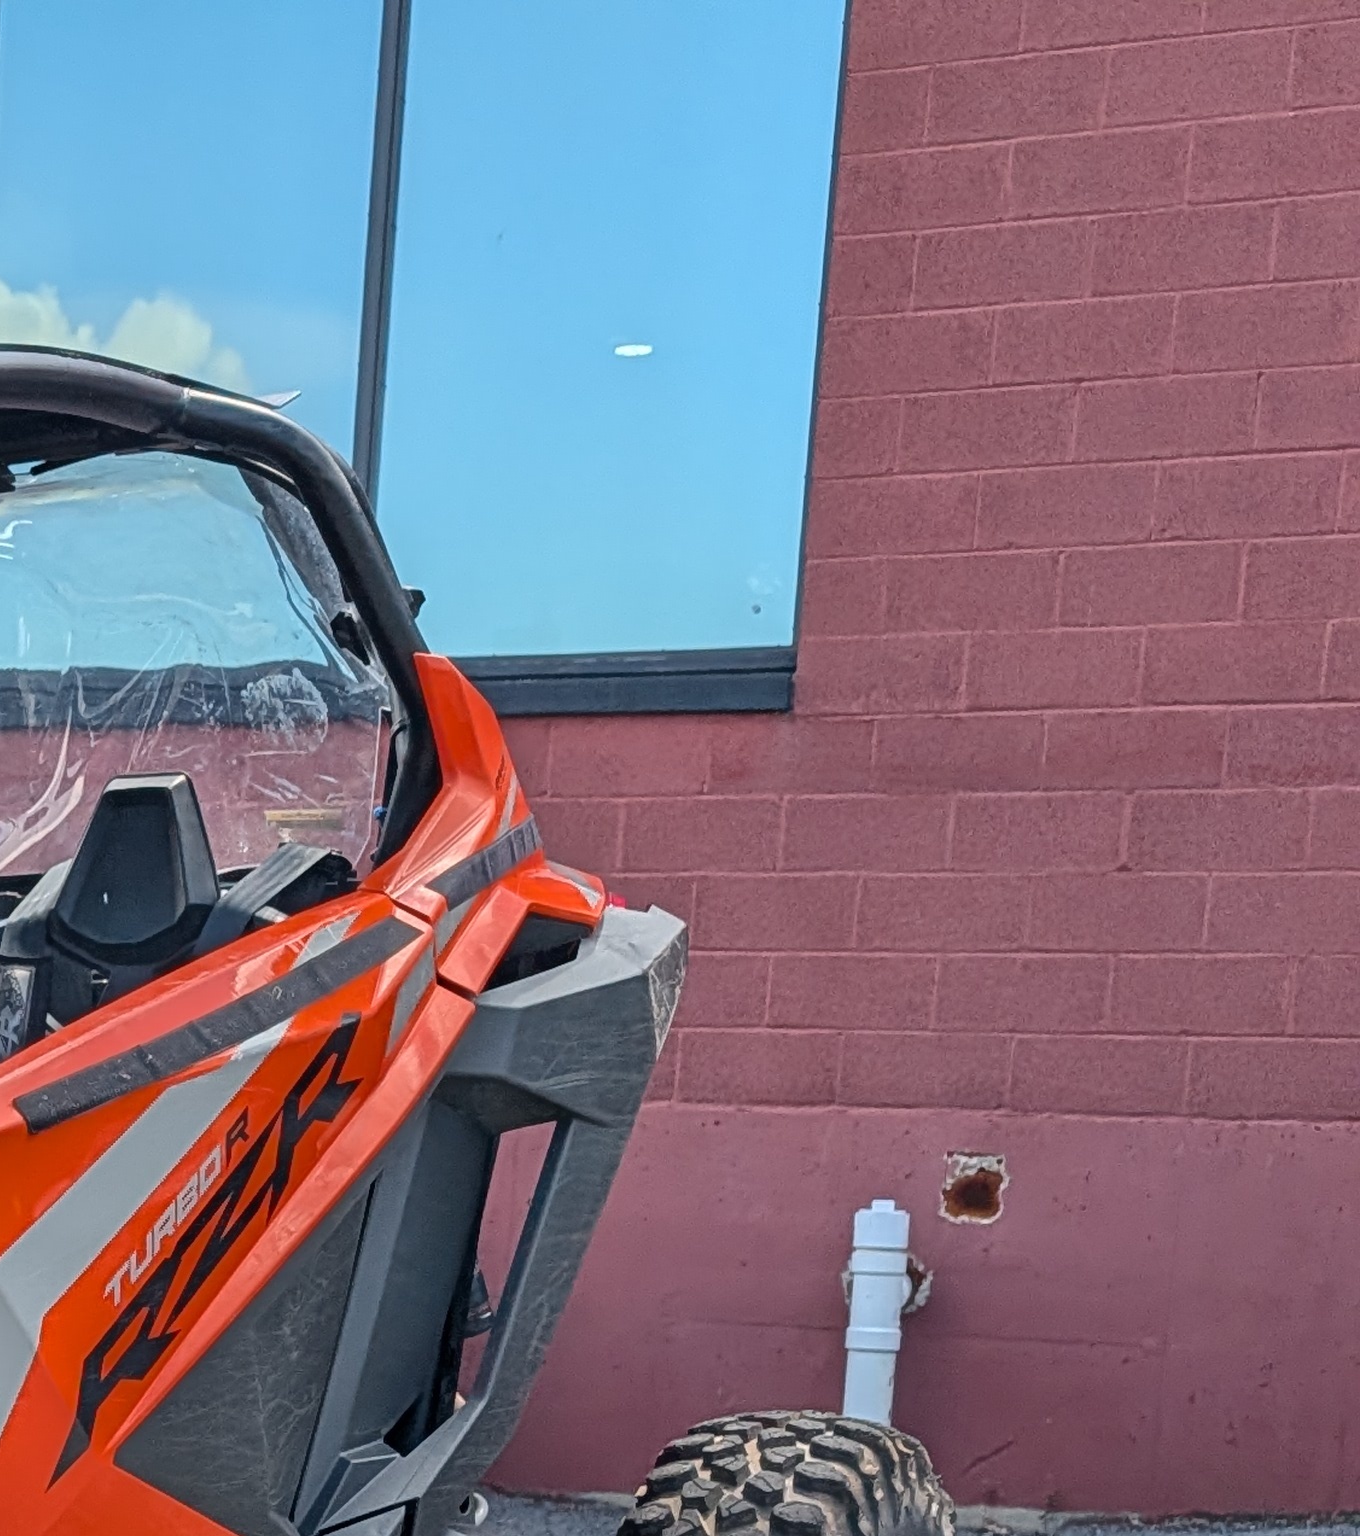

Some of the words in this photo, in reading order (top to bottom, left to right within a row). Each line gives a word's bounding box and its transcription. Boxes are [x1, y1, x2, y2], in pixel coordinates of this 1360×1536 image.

[45, 1011, 365, 1493] RZR
[102, 1142, 222, 1308] TURBO
[225, 1105, 251, 1168] R
